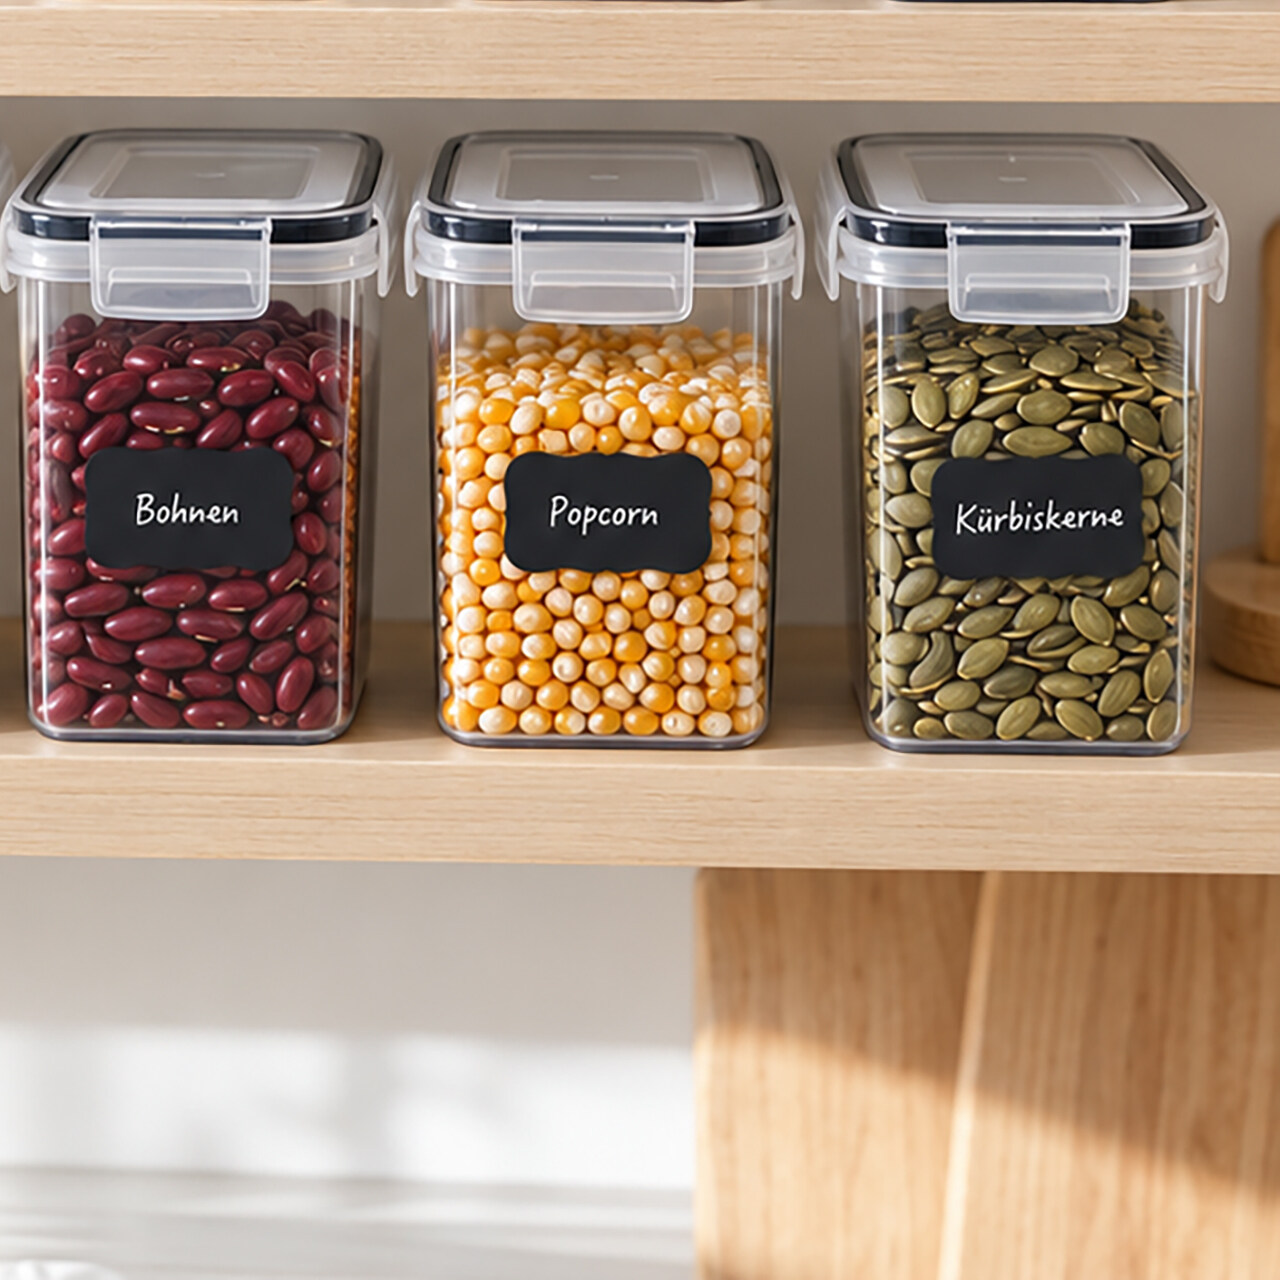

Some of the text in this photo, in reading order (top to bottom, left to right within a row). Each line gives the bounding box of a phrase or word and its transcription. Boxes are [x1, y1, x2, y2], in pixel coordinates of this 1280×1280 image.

[136, 492, 239, 526] Bohnen
[550, 495, 658, 536] Popcorn
[956, 499, 1124, 536] Kürbiskerne
